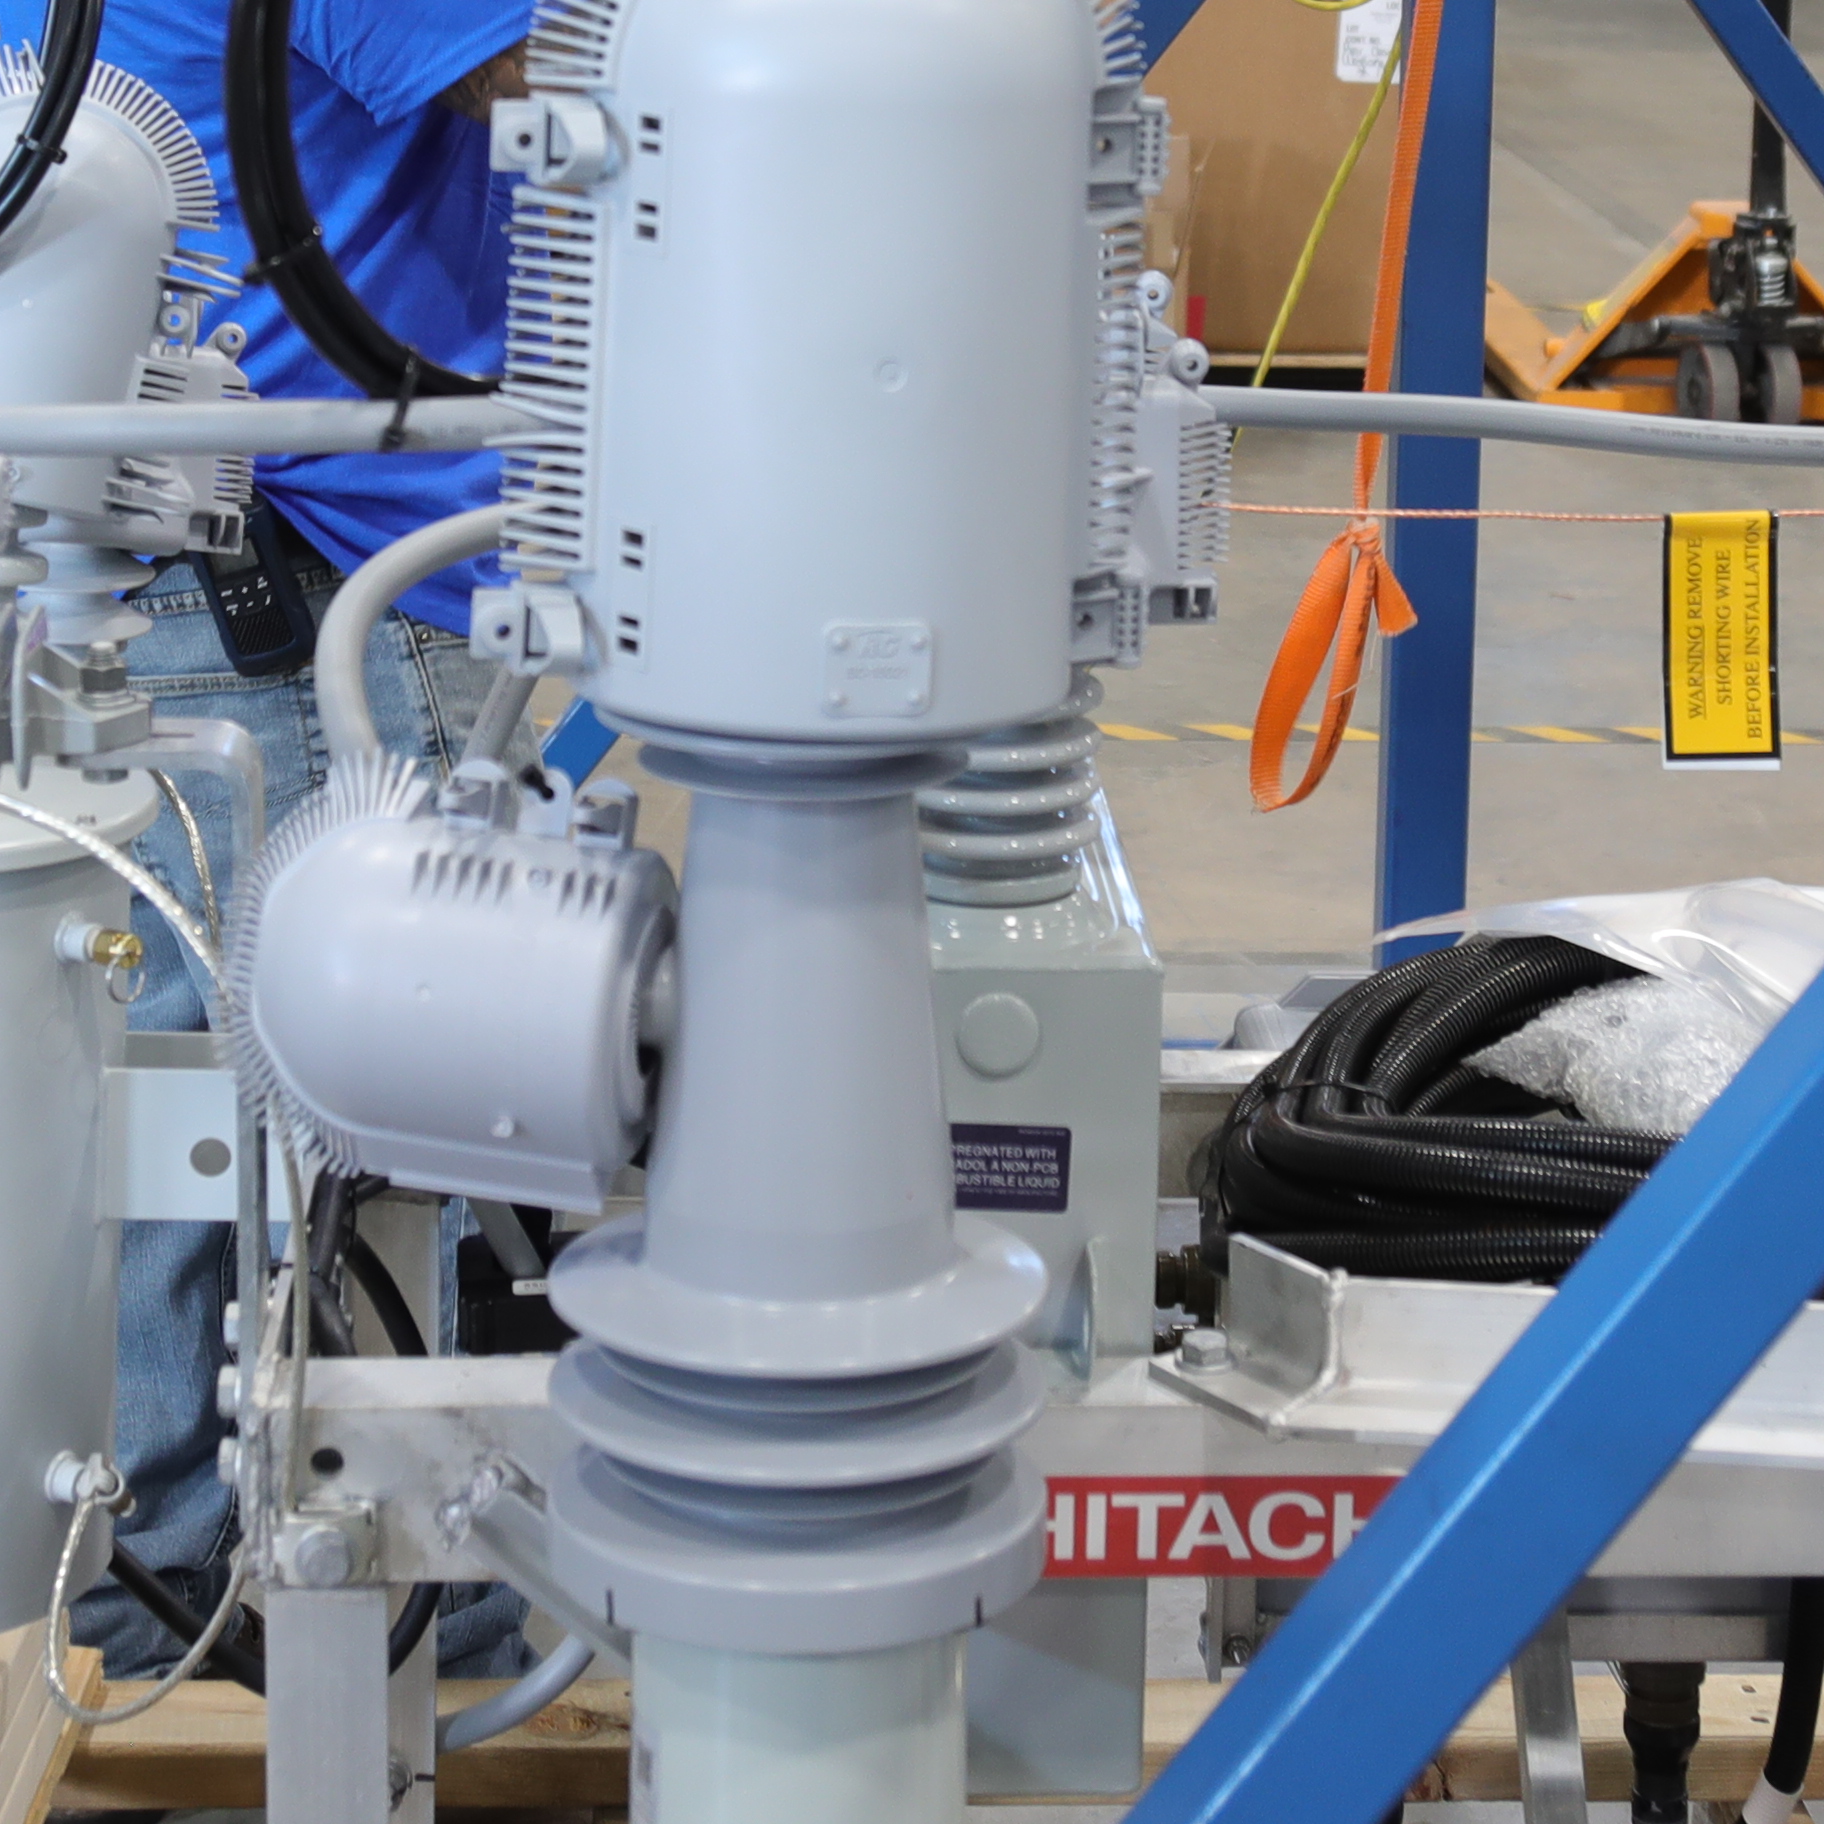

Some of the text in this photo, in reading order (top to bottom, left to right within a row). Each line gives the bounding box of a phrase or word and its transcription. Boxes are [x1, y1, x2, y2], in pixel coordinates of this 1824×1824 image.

[1687, 536, 1706, 720] WARNING REMOVE
[1716, 550, 1732, 705] SHORTING WIRE
[1744, 519, 1762, 739] BEFORE INSTALLATION
[952, 1143, 1057, 1159] REGNATED WITH
[956, 1158, 987, 1172] ADOL
[1001, 1161, 1059, 1174] NON-PCB
[956, 1173, 1060, 1189] BUSTIBLE LIQUID
